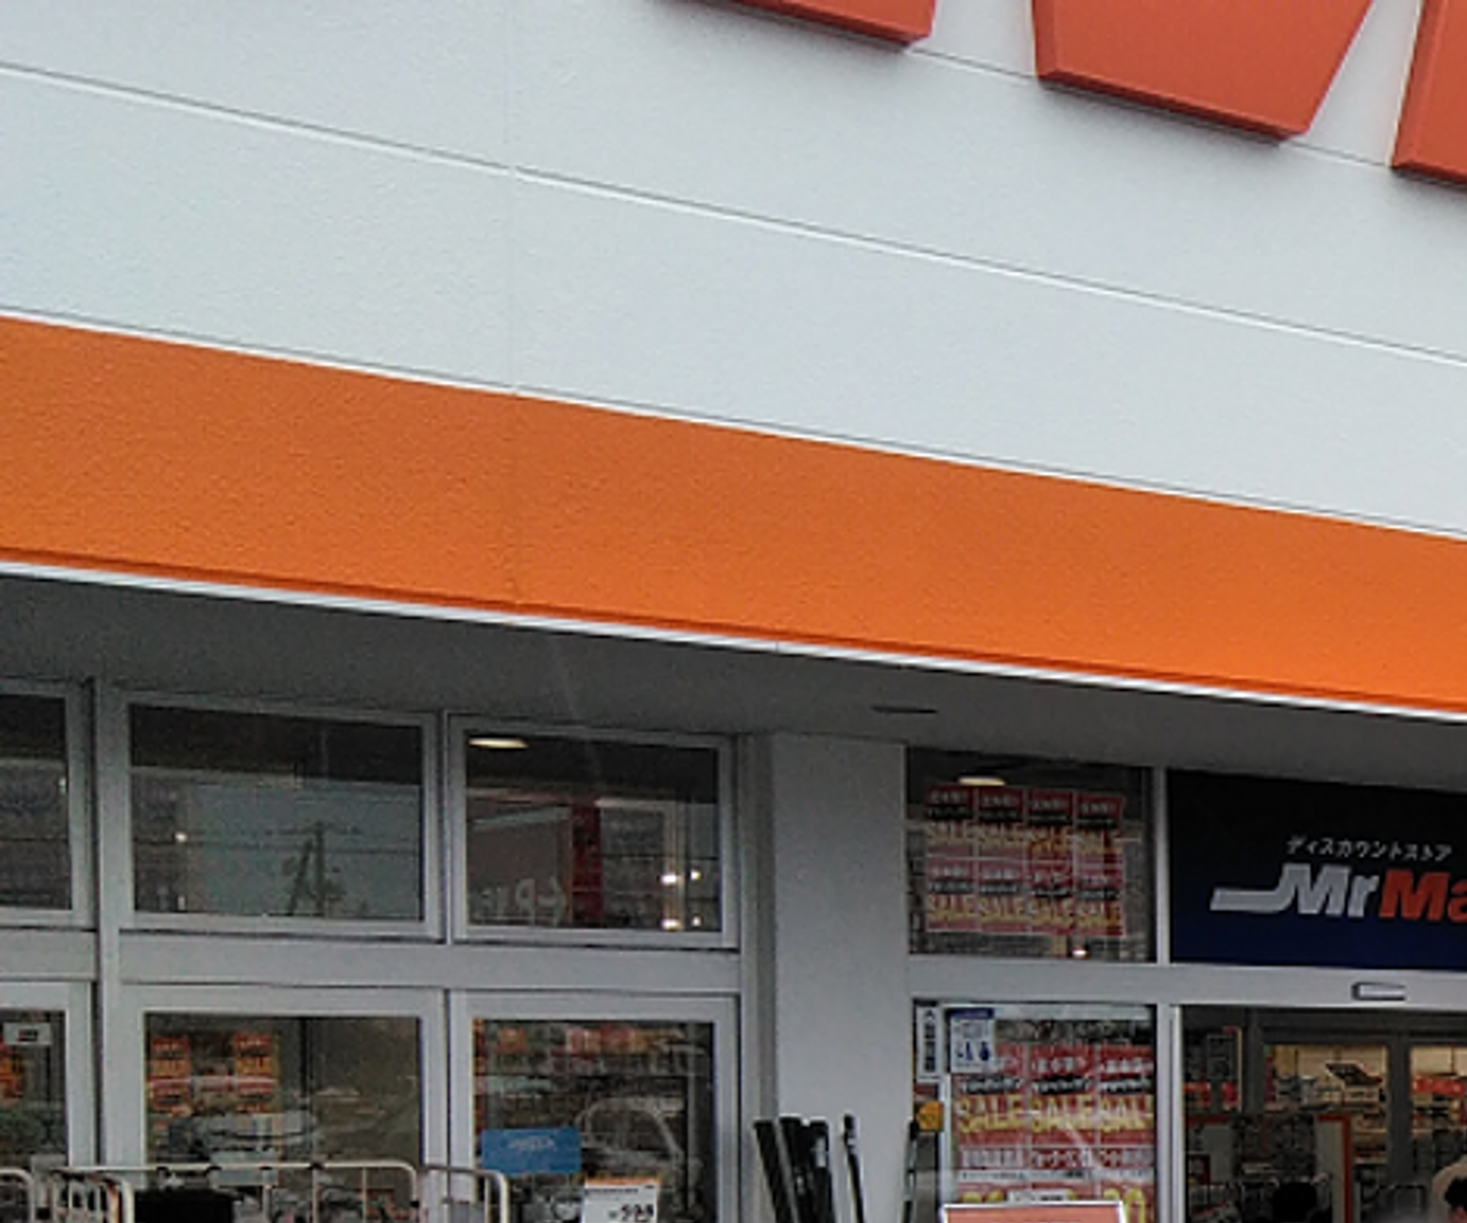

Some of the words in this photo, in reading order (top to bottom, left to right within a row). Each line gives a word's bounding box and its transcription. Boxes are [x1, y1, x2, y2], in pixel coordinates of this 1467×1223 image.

[1286, 835, 1452, 861] ディスカウントストア
